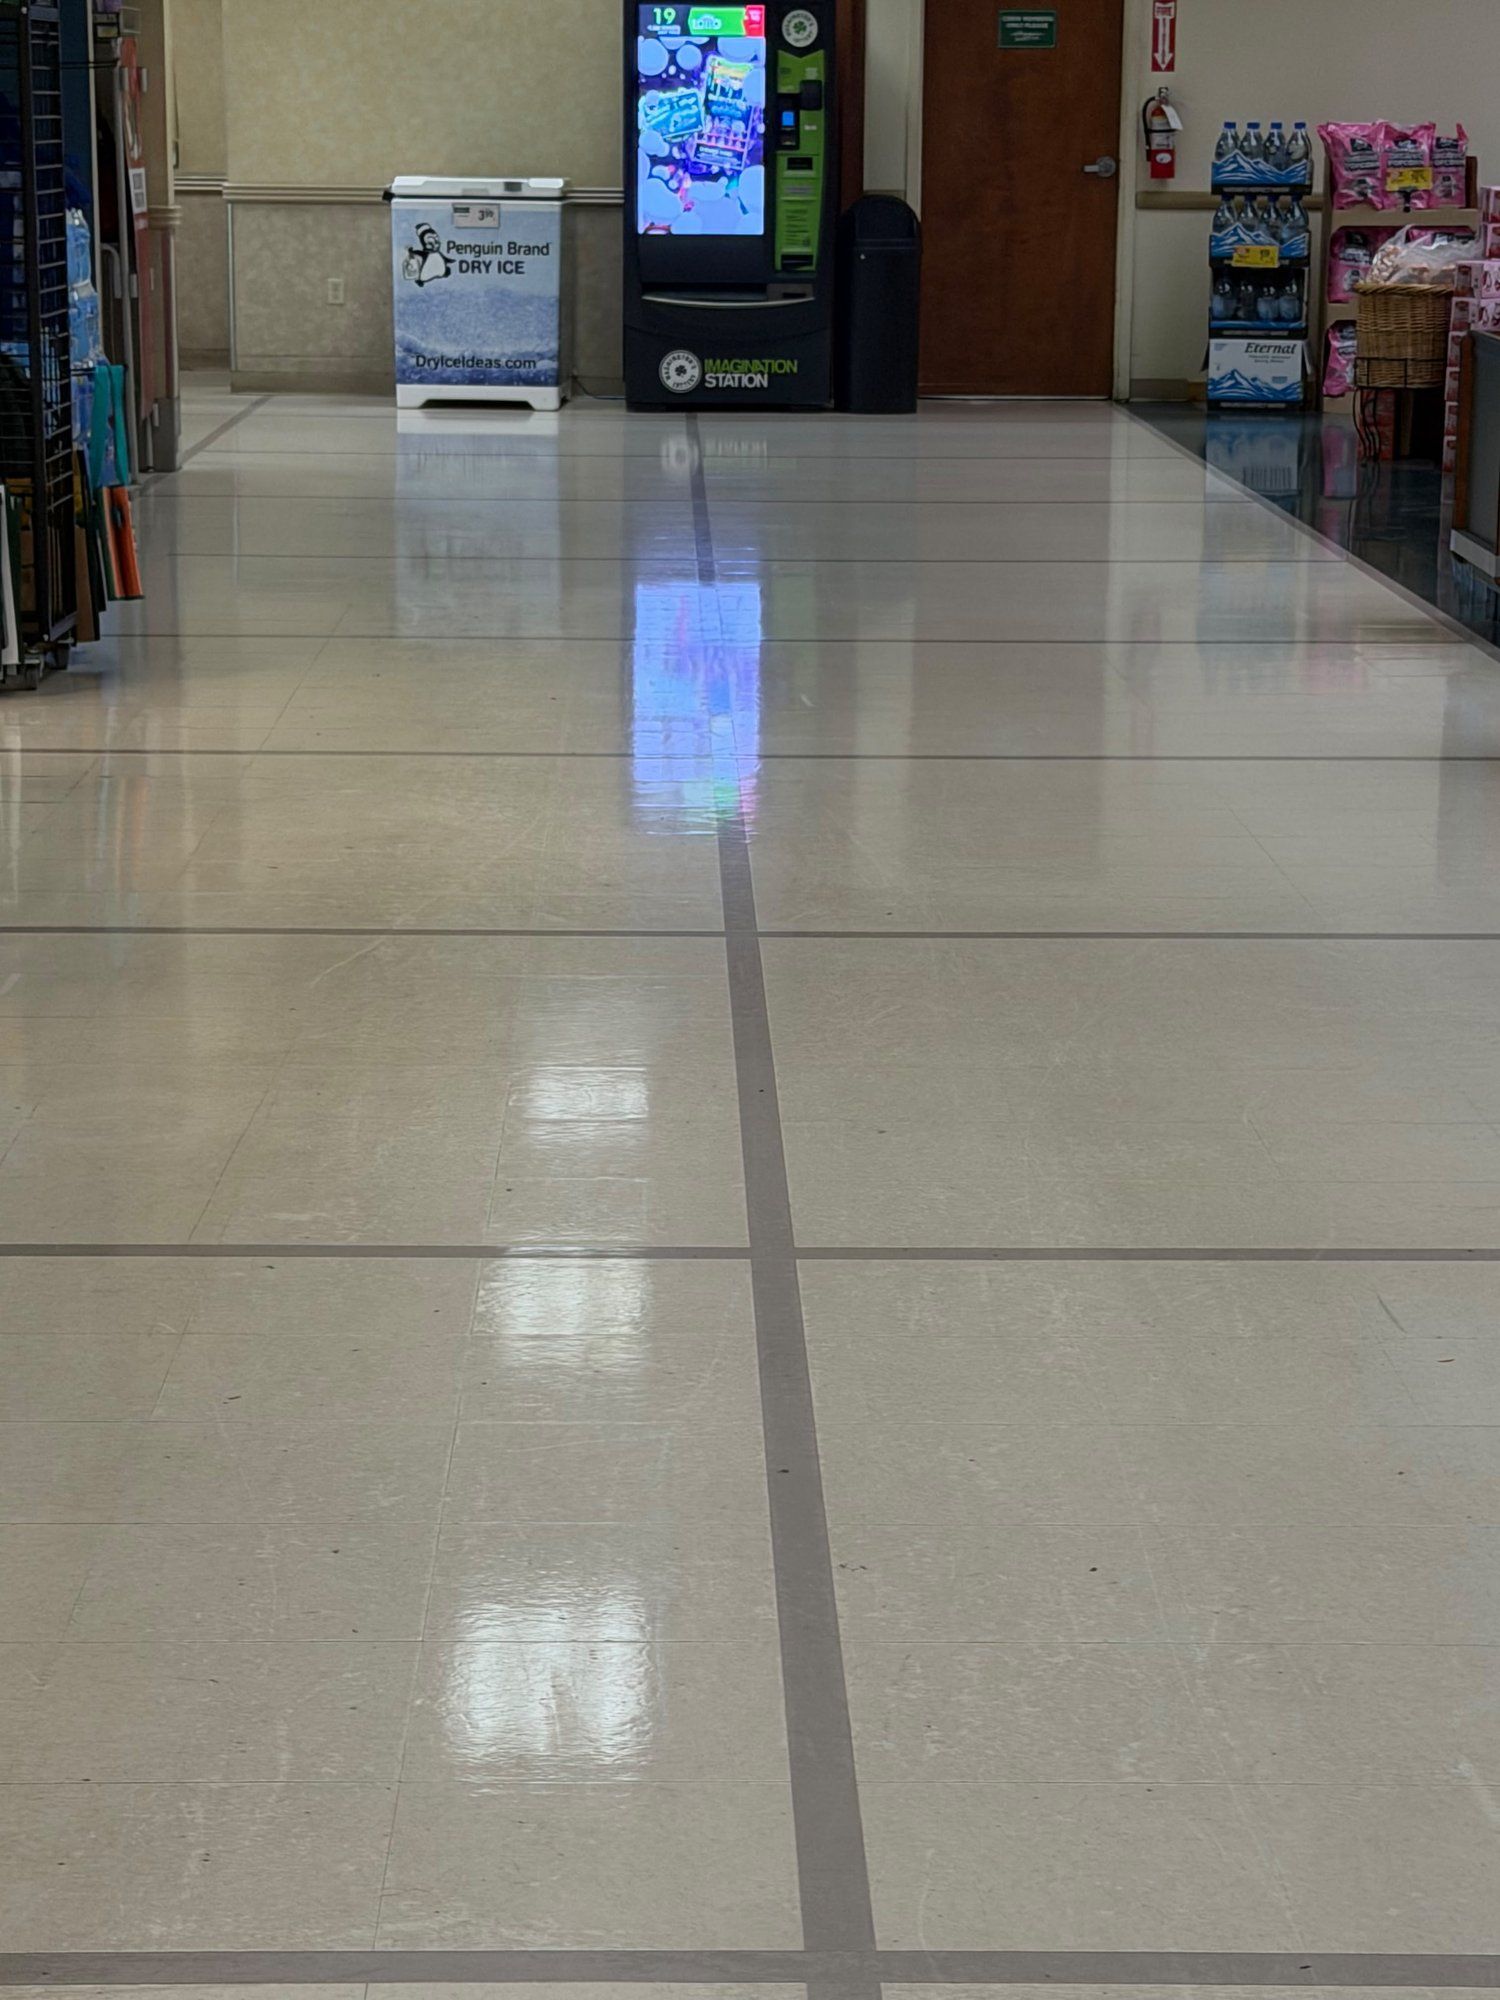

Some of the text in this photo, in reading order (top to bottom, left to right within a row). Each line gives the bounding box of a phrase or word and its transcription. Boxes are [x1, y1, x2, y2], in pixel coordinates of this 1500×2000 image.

[653, 7, 676, 25] 19
[446, 240, 550, 258] Penguin Brand
[458, 260, 526, 275] DRY ICE
[1244, 342, 1297, 354] Eternal
[704, 359, 798, 373] IMAGINATION
[704, 374, 768, 388] STATION
